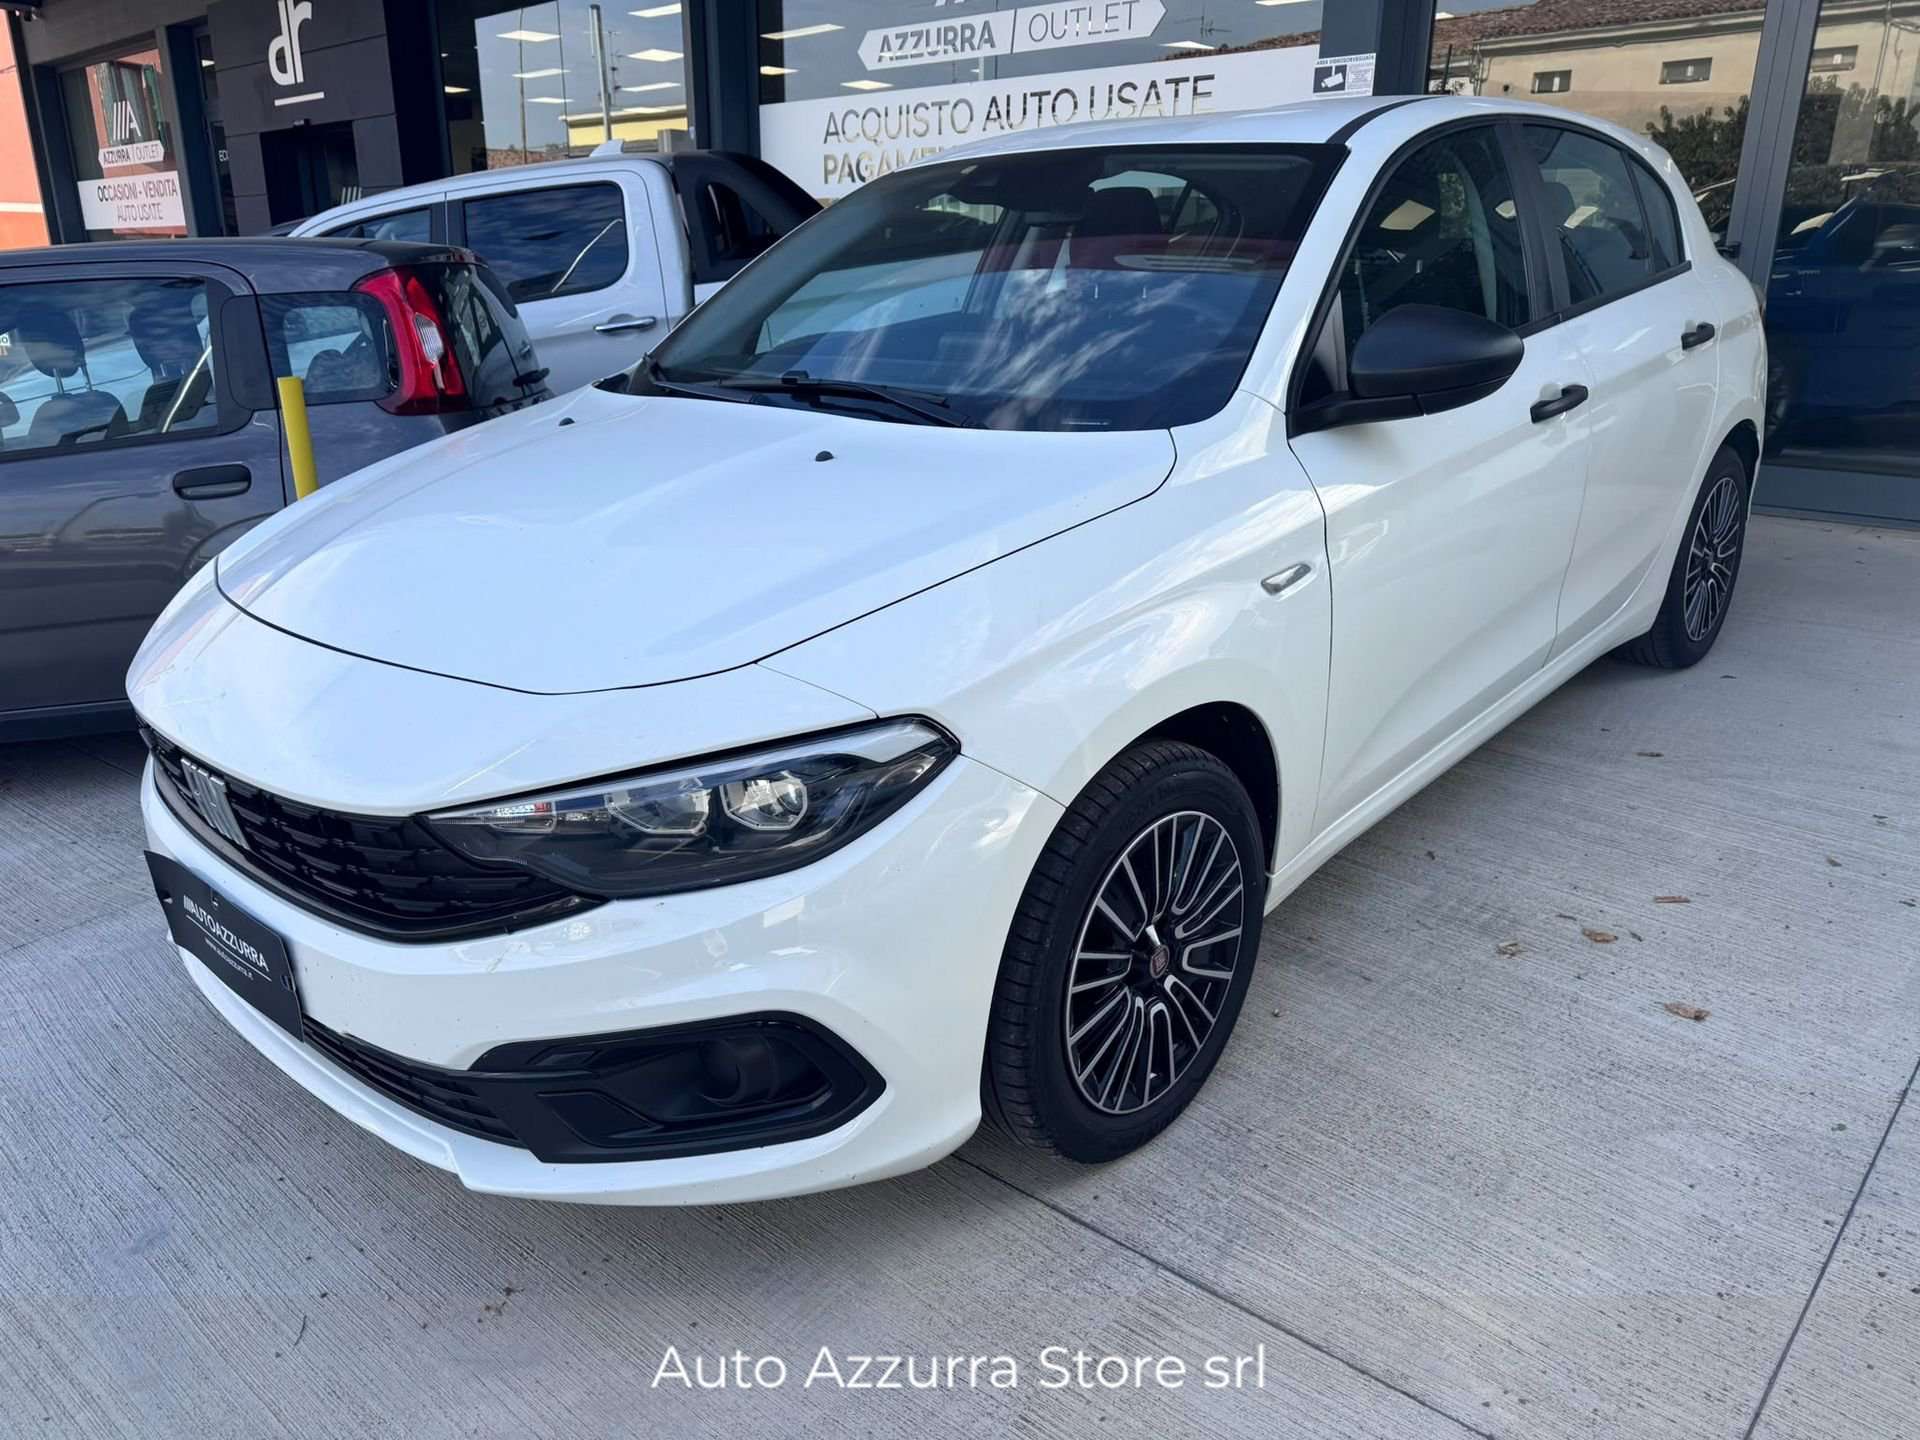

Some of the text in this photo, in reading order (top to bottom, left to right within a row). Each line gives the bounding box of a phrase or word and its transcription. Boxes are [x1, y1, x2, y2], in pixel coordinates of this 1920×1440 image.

[267, 0, 312, 86] dr
[877, 0, 1141, 63] AZZURRA OUTLET
[823, 74, 1216, 146] ACQUISTO AUTO USATE
[103, 144, 160, 165] AZZURRA OUTLET
[97, 183, 137, 202] OCCASIONI
[143, 178, 178, 199] VENDITA
[117, 202, 164, 222] AUTO USATE
